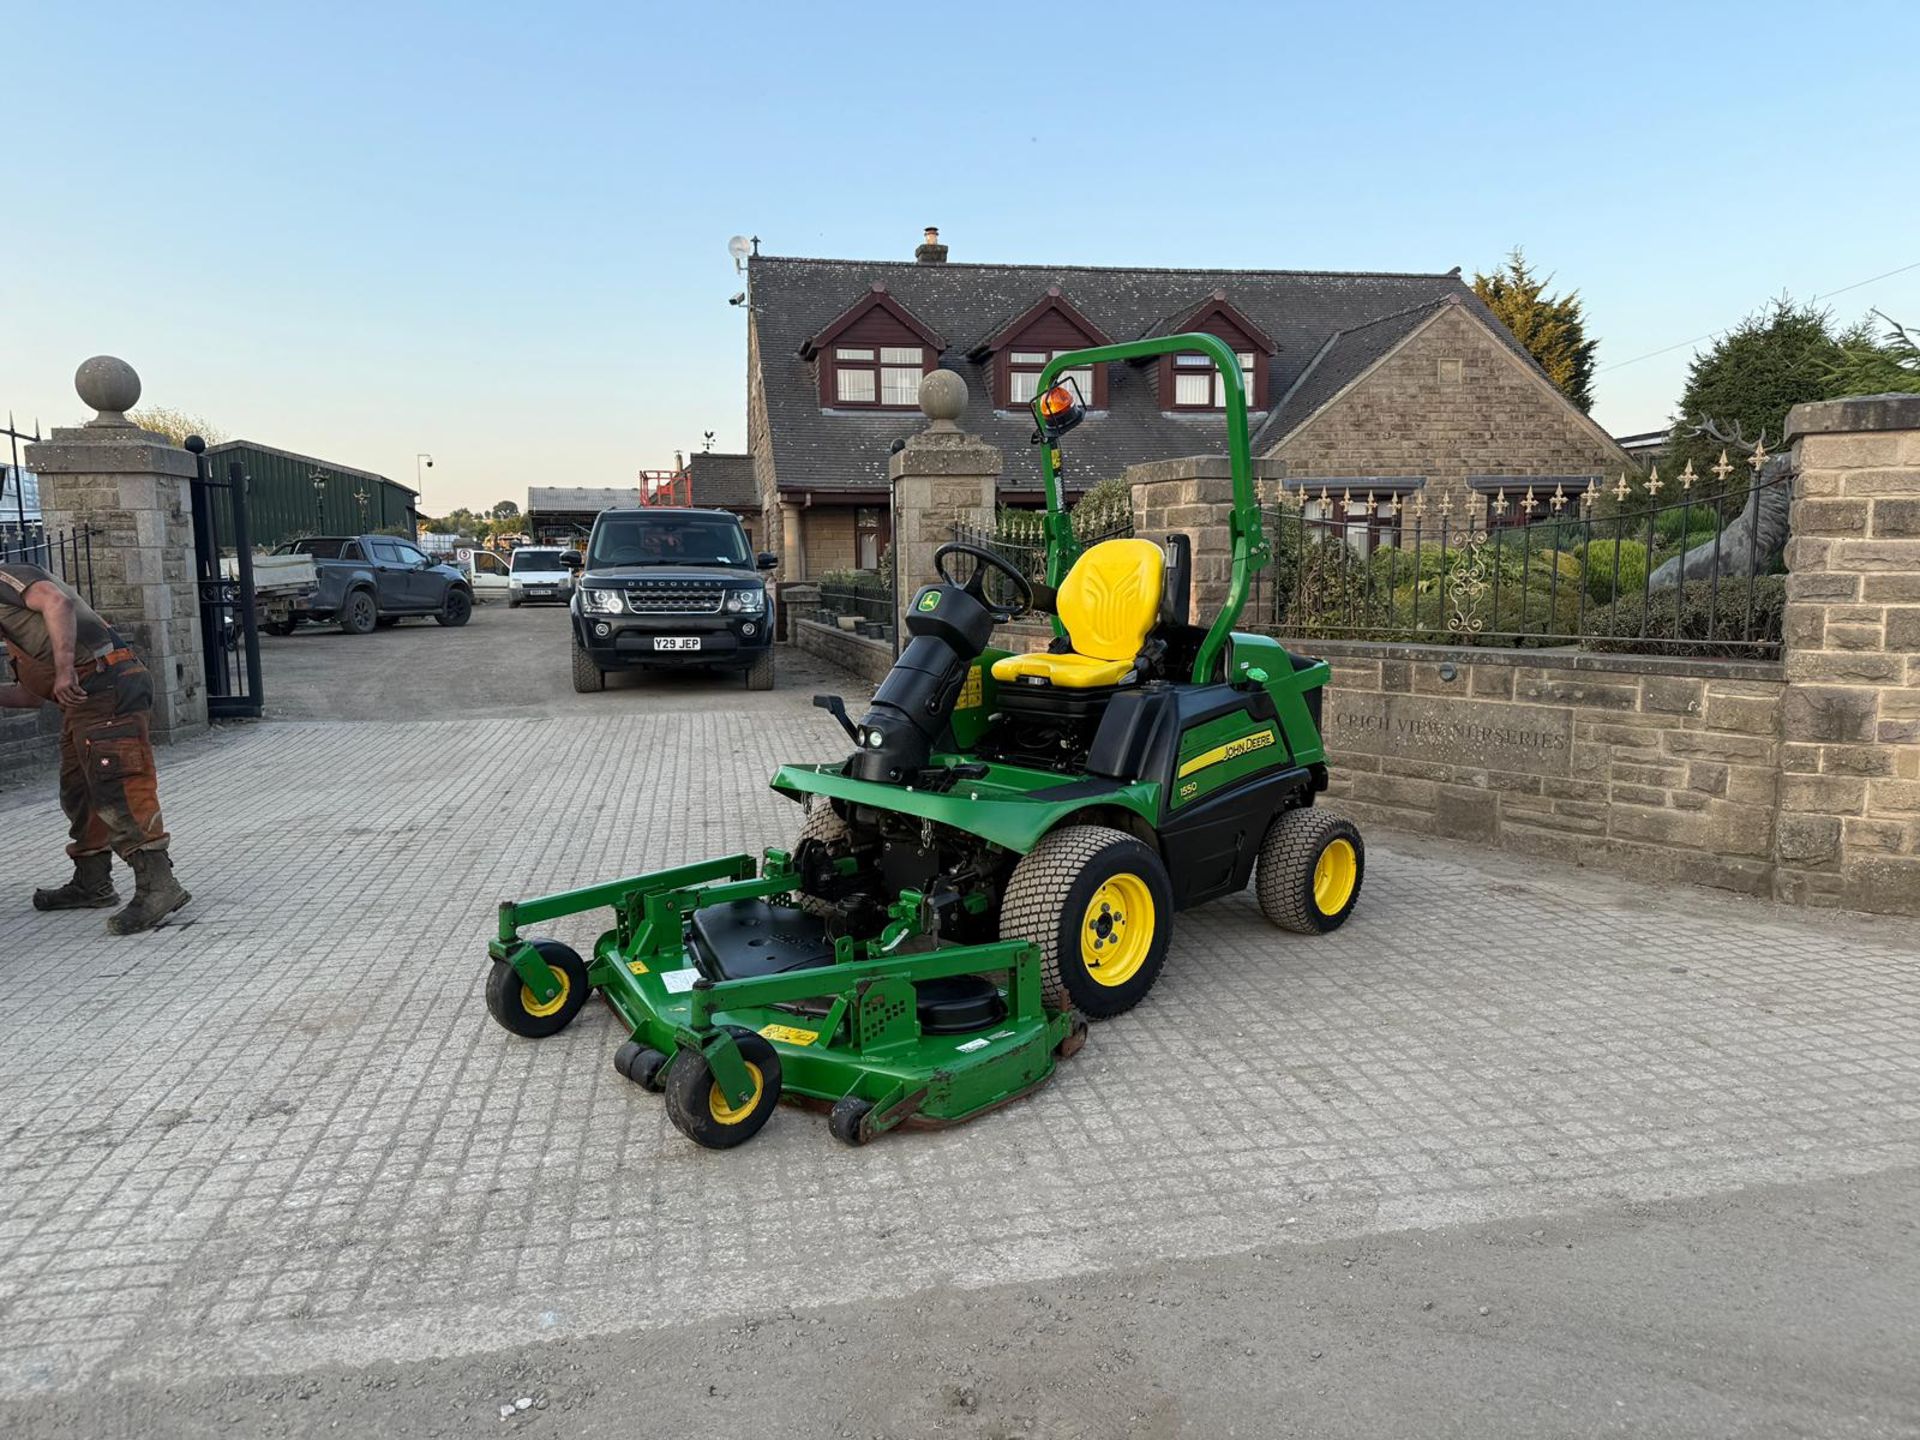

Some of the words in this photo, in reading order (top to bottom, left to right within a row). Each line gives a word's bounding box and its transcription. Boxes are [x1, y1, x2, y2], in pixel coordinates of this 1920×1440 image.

[655, 639, 676, 649] Y29
[679, 639, 699, 649] JEP
[1224, 743, 1246, 760] JOHN
[1246, 733, 1272, 751] DEERE
[1452, 722, 1566, 751] NURSERIES
[1180, 781, 1198, 797] 1550
